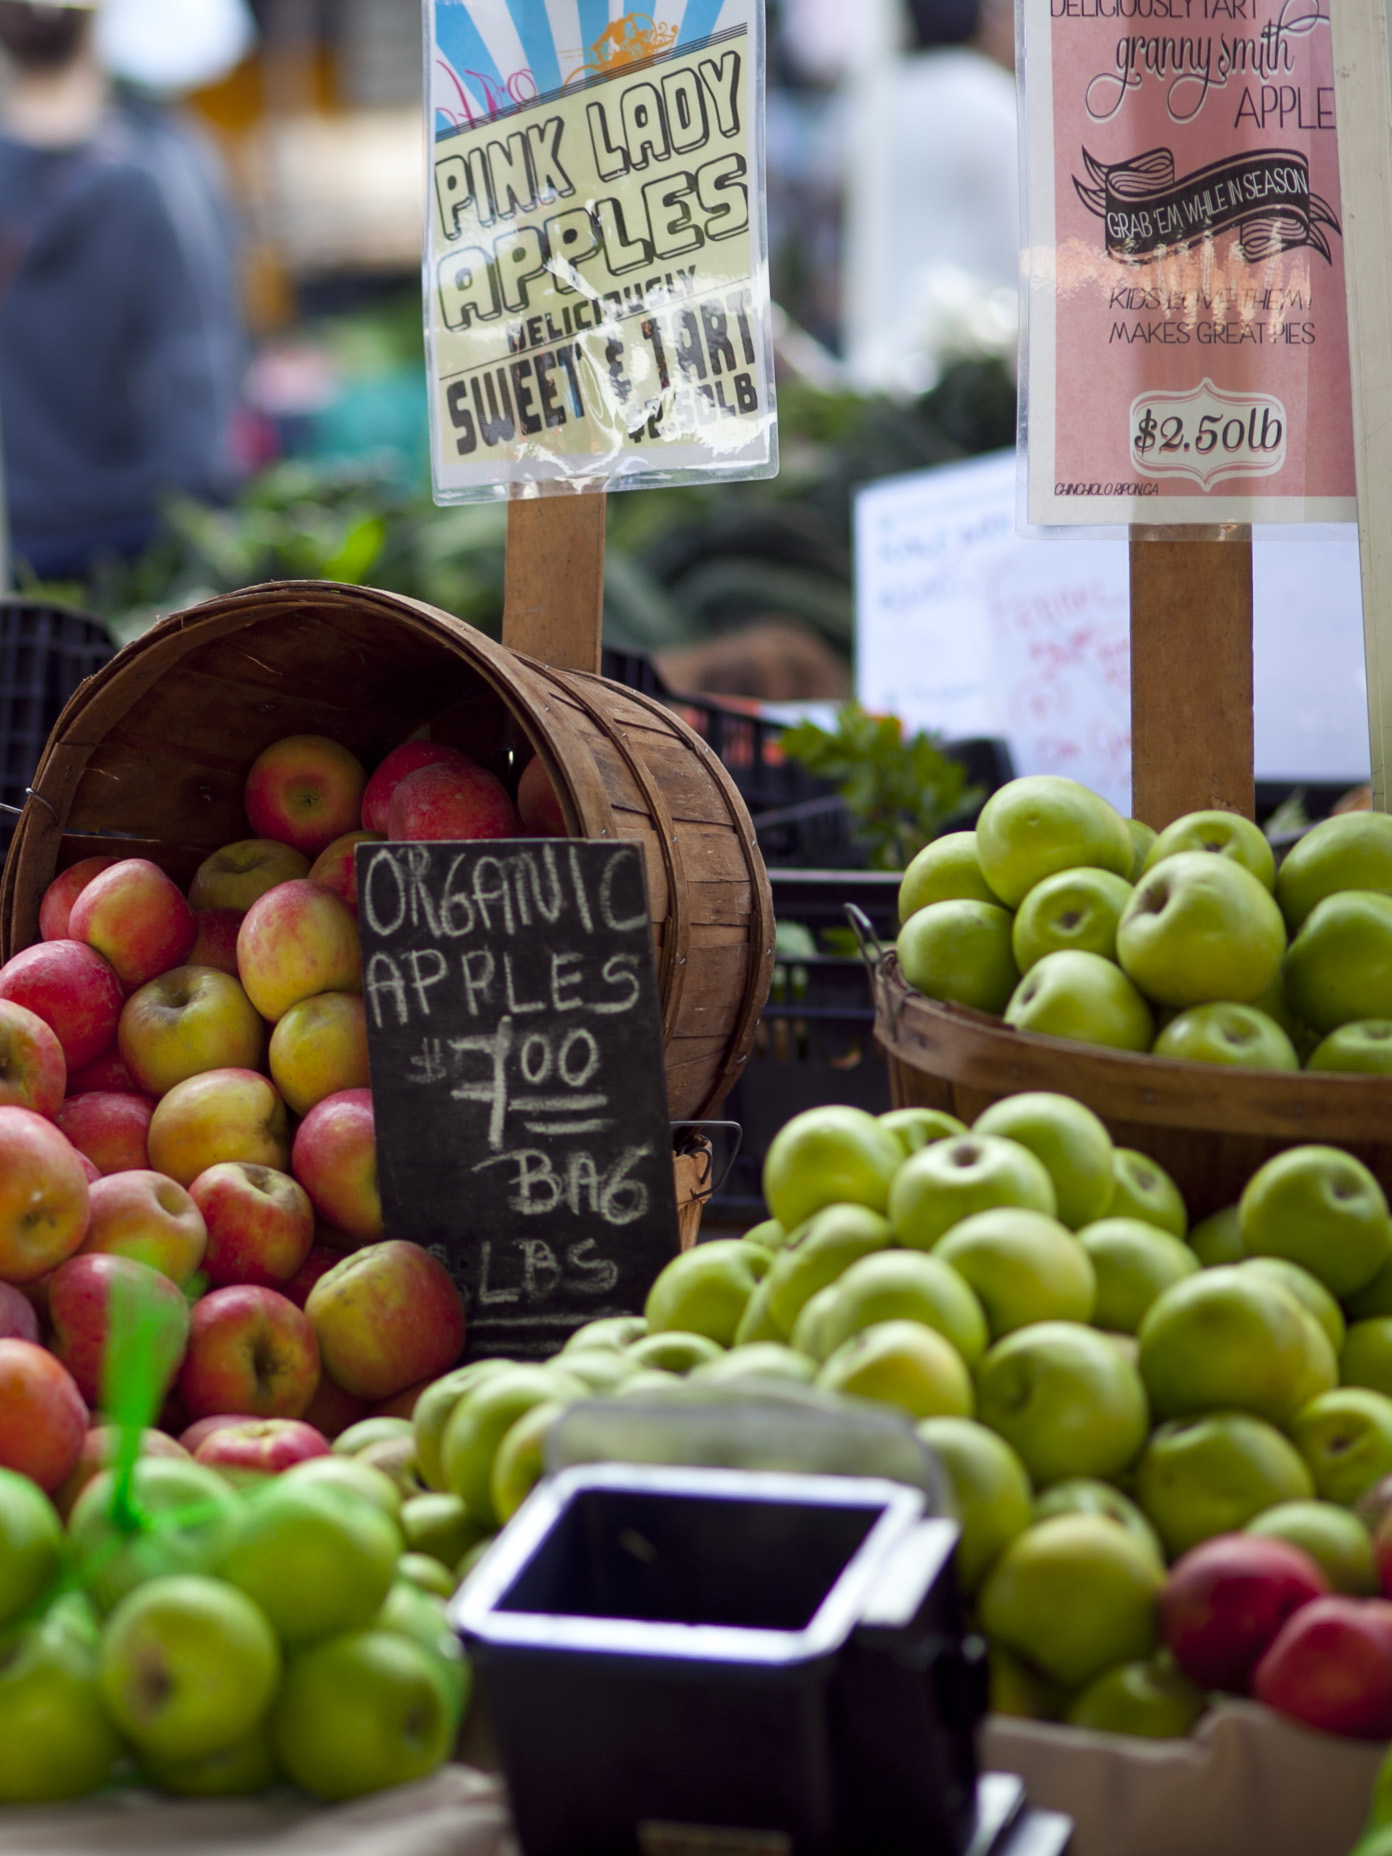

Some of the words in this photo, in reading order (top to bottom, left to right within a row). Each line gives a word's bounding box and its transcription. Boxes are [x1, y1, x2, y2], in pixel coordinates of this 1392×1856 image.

[1086, 36, 1227, 122] granny
[1234, 85, 1337, 129] APPLE
[434, 116, 576, 240] PINK
[586, 50, 741, 183] LADY
[437, 152, 749, 333] APPLES
[1107, 211, 1153, 239] GRAB
[1182, 183, 1229, 225] WHILE
[1227, 177, 1244, 206] IN
[1243, 167, 1309, 199] SEASON
[1109, 287, 1161, 310] KIDS
[1109, 321, 1190, 345] MAKES
[1196, 321, 1268, 345] GREAT
[1272, 322, 1316, 345] PIES
[446, 340, 584, 456] SWEET
[641, 288, 756, 391] TART
[1133, 406, 1285, 457] $2.50lb
[364, 843, 648, 938] ORGANIC
[367, 947, 641, 1028] APPLES
